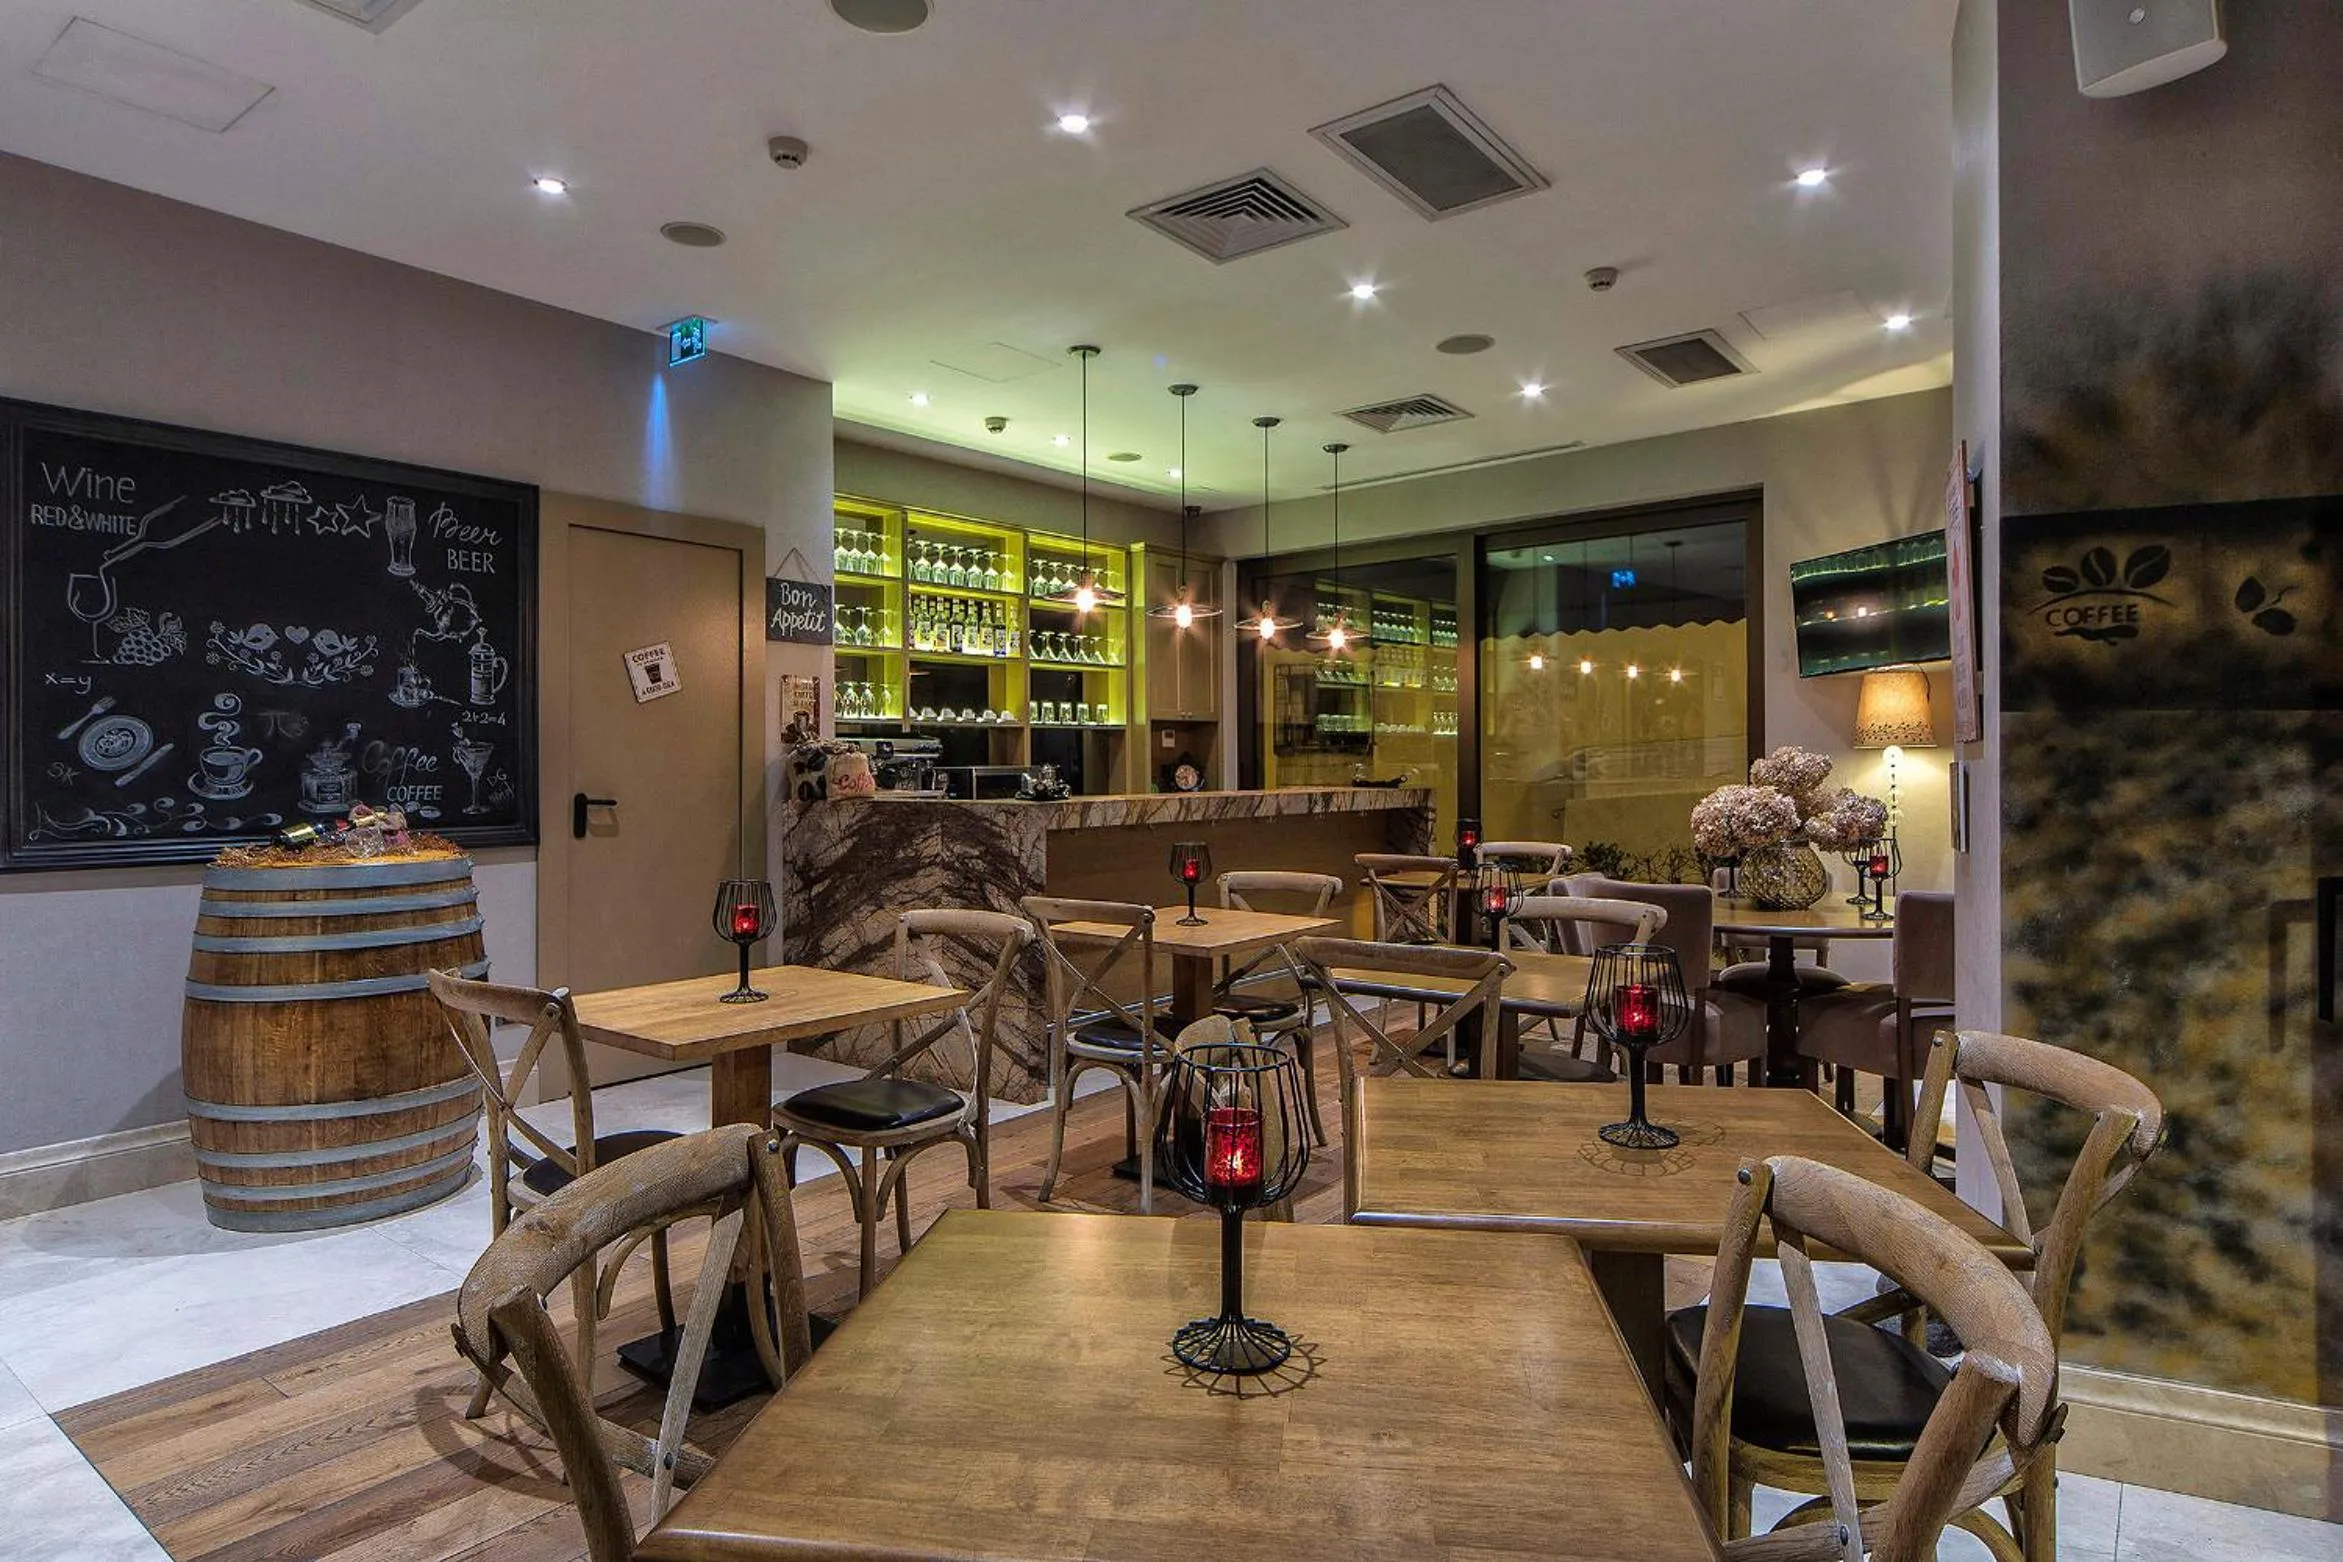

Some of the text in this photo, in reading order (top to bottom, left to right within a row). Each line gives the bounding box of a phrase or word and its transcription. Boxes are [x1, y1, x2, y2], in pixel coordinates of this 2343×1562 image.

[41, 462, 136, 504] Wine
[31, 503, 137, 536] RED&WHITE
[428, 501, 502, 546] Beer
[447, 548, 496, 574] BEER
[781, 583, 816, 606] Bon
[771, 610, 826, 636] Appetit
[2045, 604, 2138, 628] COFFEE
[632, 648, 665, 663] COFFEE
[362, 740, 439, 786] Coffee
[386, 784, 443, 802] COFFEE
